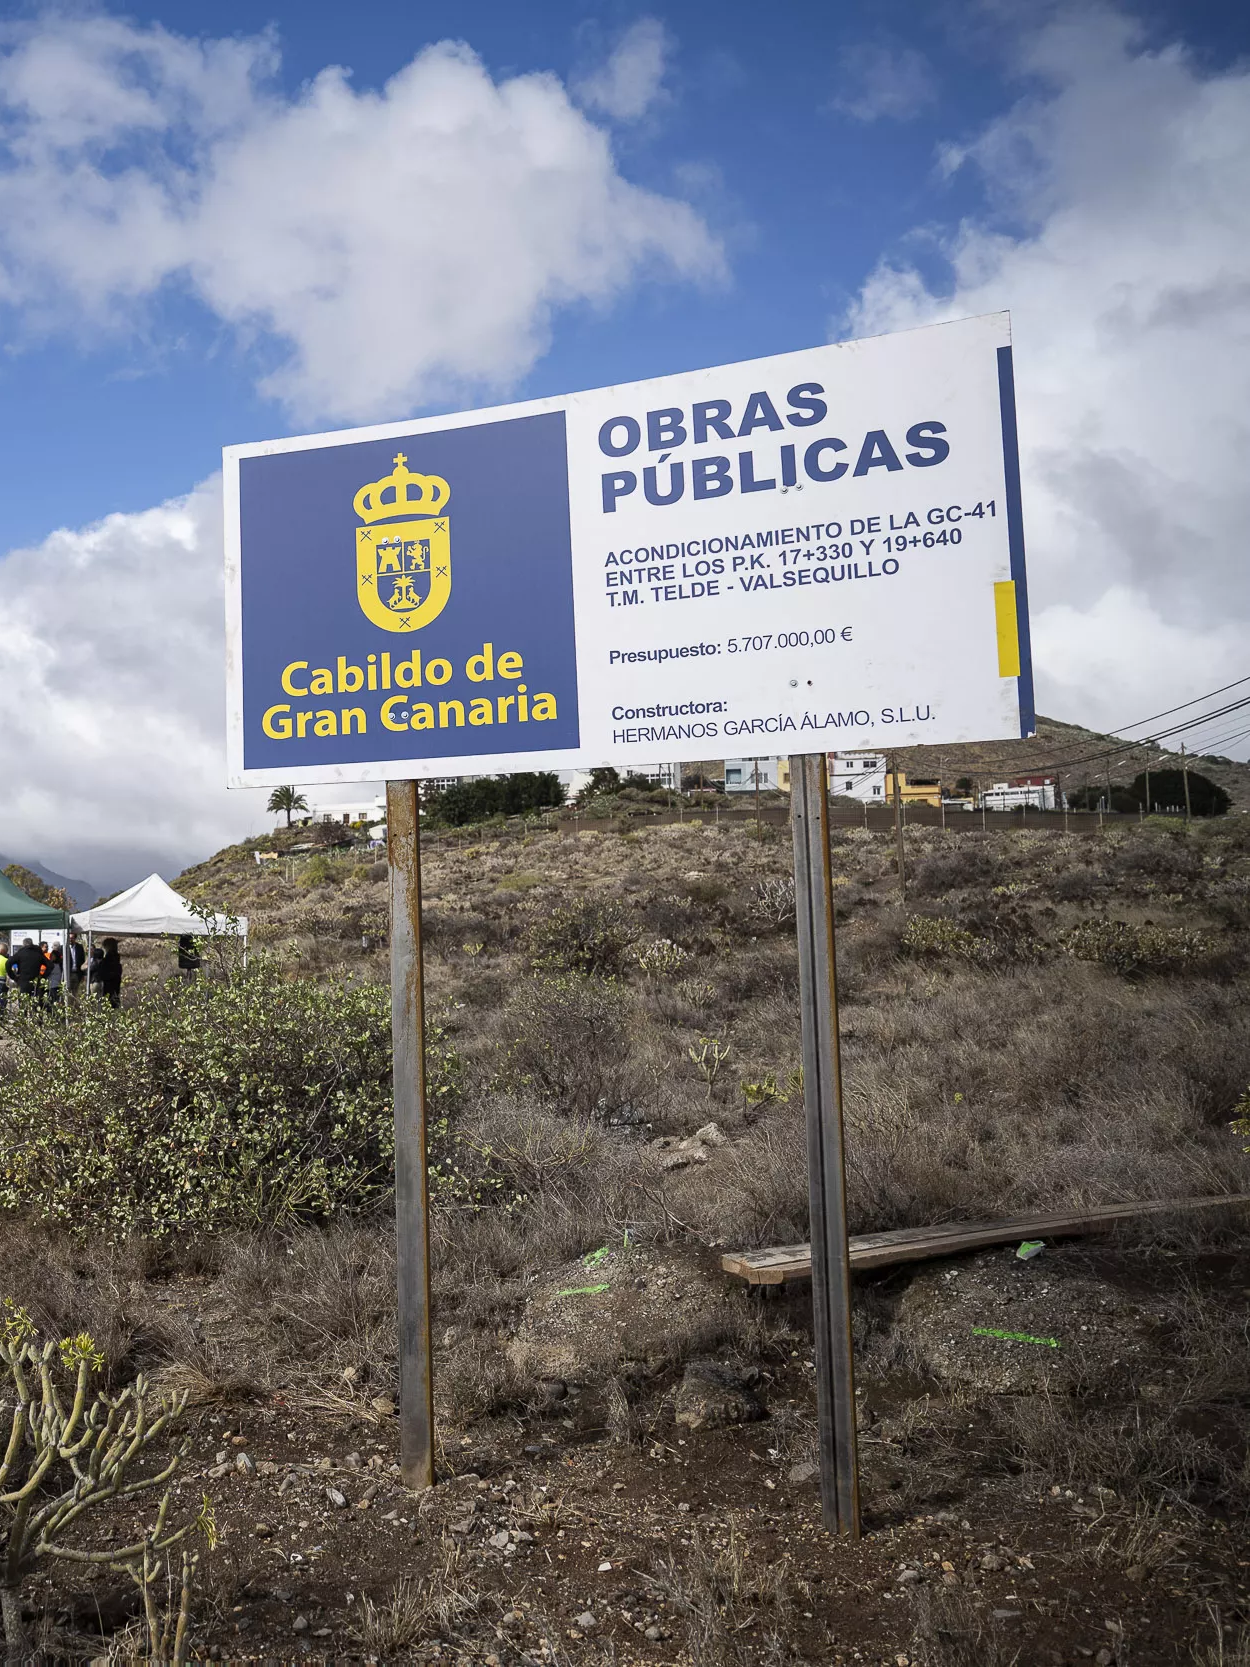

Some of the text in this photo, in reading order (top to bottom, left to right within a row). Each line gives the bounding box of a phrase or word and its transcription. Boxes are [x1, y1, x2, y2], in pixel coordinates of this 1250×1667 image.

[599, 383, 828, 457] OBRAS
[602, 421, 950, 513] PÚBLICAS
[604, 500, 995, 567] ACONDICIONAMIENTO DE LA GC-41
[606, 528, 963, 587] ENTRE LOS P.K. 17+330 Y 19+640
[606, 589, 644, 607] T.M.
[651, 579, 720, 604] TELDE
[740, 559, 900, 592] VALSEQUILLO
[282, 642, 523, 696] Cabildo de
[610, 627, 853, 665] Presupuesto: 5.707.000,00 €
[262, 683, 557, 739] Gran Canaria
[611, 700, 728, 721] Constructora:
[613, 705, 936, 743] HERMANOS GARCÍA ÁLAMO, S.L.U.
